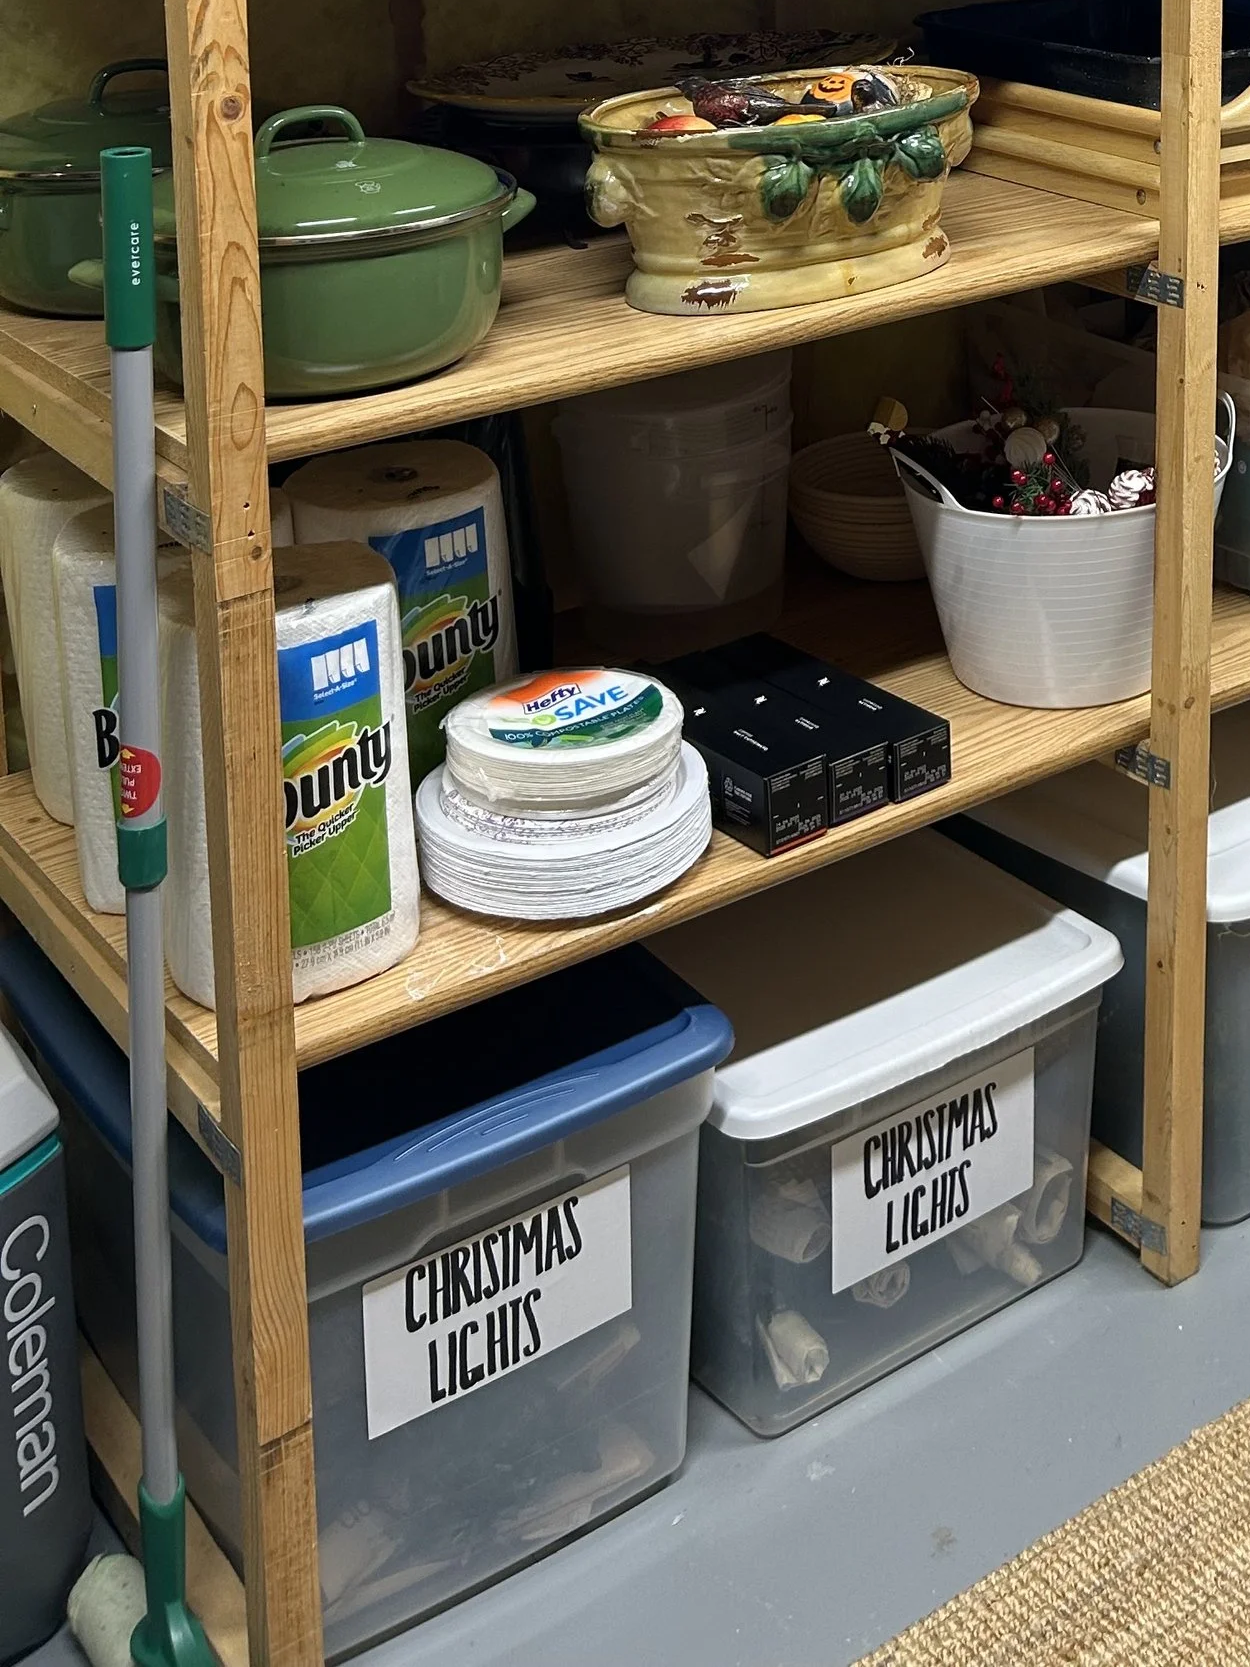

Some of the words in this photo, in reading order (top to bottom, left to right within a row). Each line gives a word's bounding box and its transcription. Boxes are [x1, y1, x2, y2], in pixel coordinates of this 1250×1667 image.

[130, 222, 141, 286] evercare
[402, 595, 499, 693] unty
[413, 691, 442, 713] Picker
[443, 673, 468, 696] Upper
[415, 688, 432, 703] The
[433, 666, 466, 693] Quicker
[527, 686, 576, 712] Hefty
[554, 686, 629, 721] SAVE
[504, 732, 534, 742] 100%
[536, 714, 610, 738] COMPOSTABLE
[611, 695, 645, 717] PLATES
[285, 720, 392, 829] unty
[293, 833, 327, 858] Picker
[328, 812, 357, 838] Upper
[295, 828, 317, 845] The
[317, 803, 355, 836] Quicker
[863, 1082, 998, 1199] CHRISTMAS
[885, 1160, 972, 1254] LIGHTS
[404, 1196, 582, 1334] CHRISTMAS
[0, 1214, 61, 1517] Coleman
[429, 1288, 541, 1403] LIGHTS
